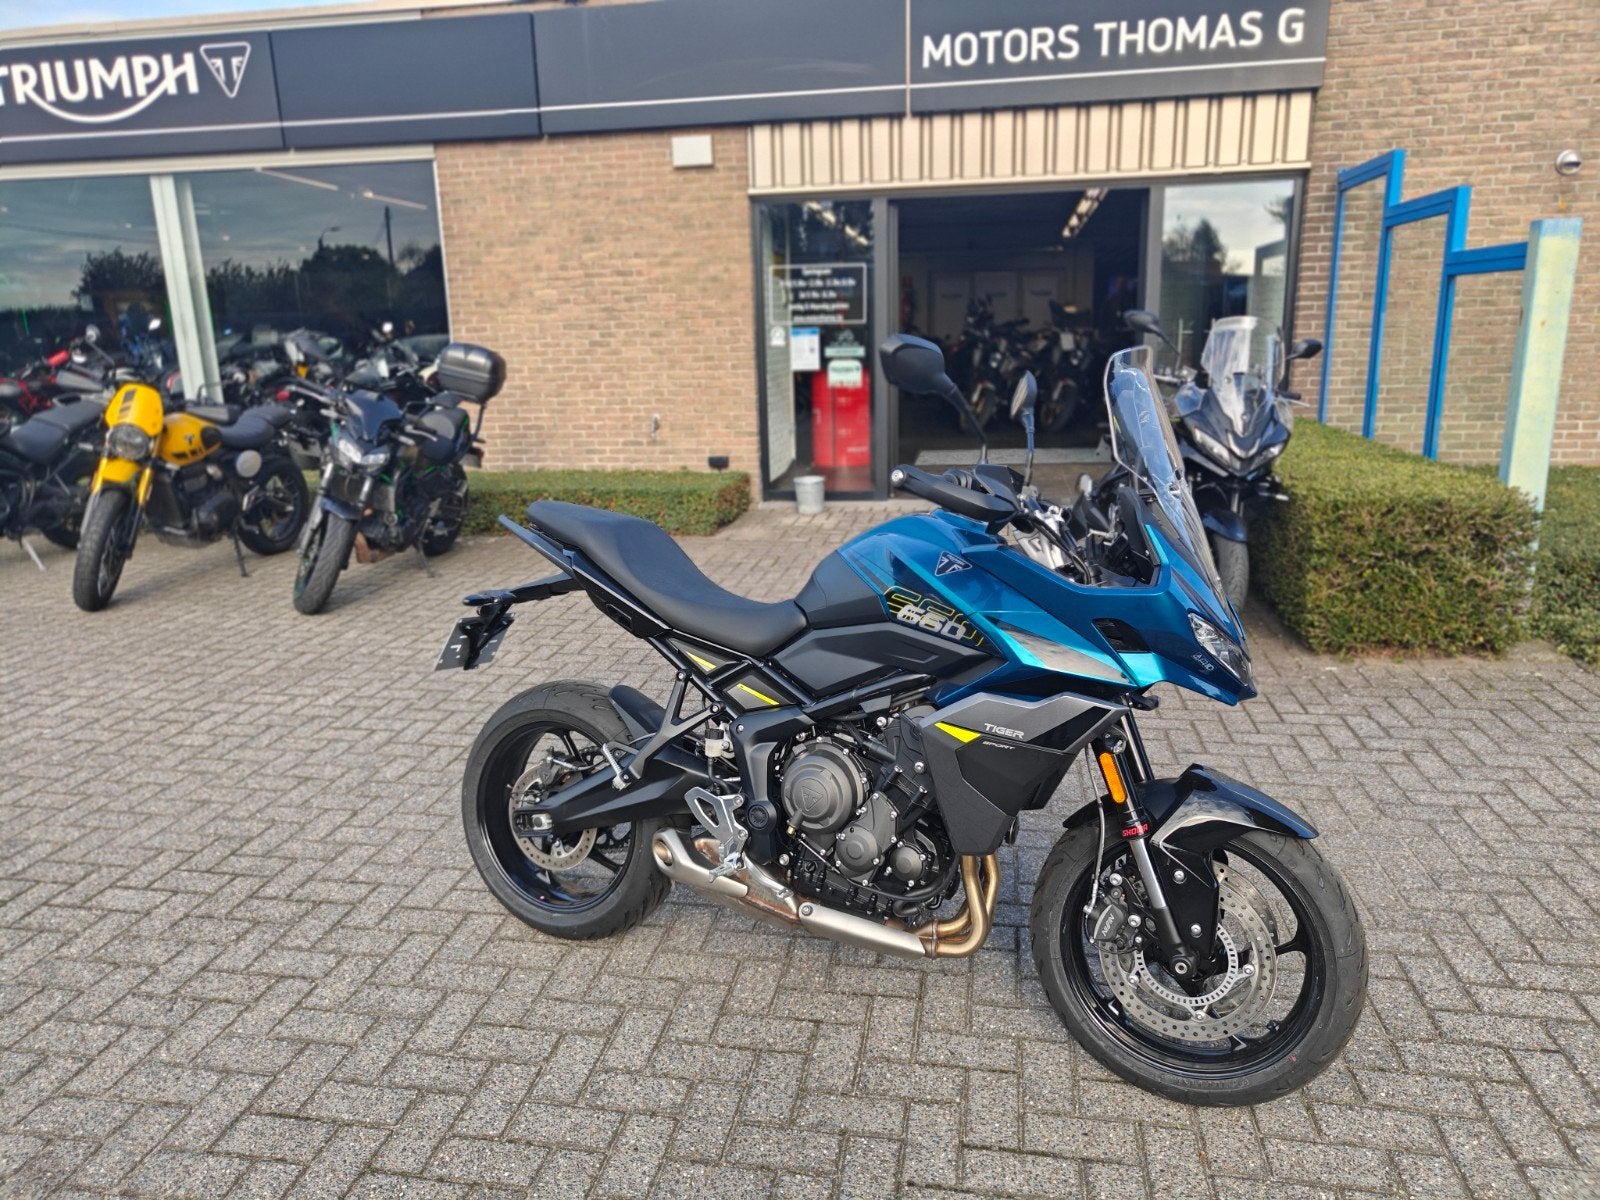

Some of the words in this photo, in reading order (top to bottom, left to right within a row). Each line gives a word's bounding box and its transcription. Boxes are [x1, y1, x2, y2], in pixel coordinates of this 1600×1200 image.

[922, 25, 1080, 69] MOTORS
[1094, 11, 1263, 57] THOMAS
[1277, 7, 1306, 45] G
[897, 604, 966, 640] 660
[984, 723, 1025, 739] TIGER
